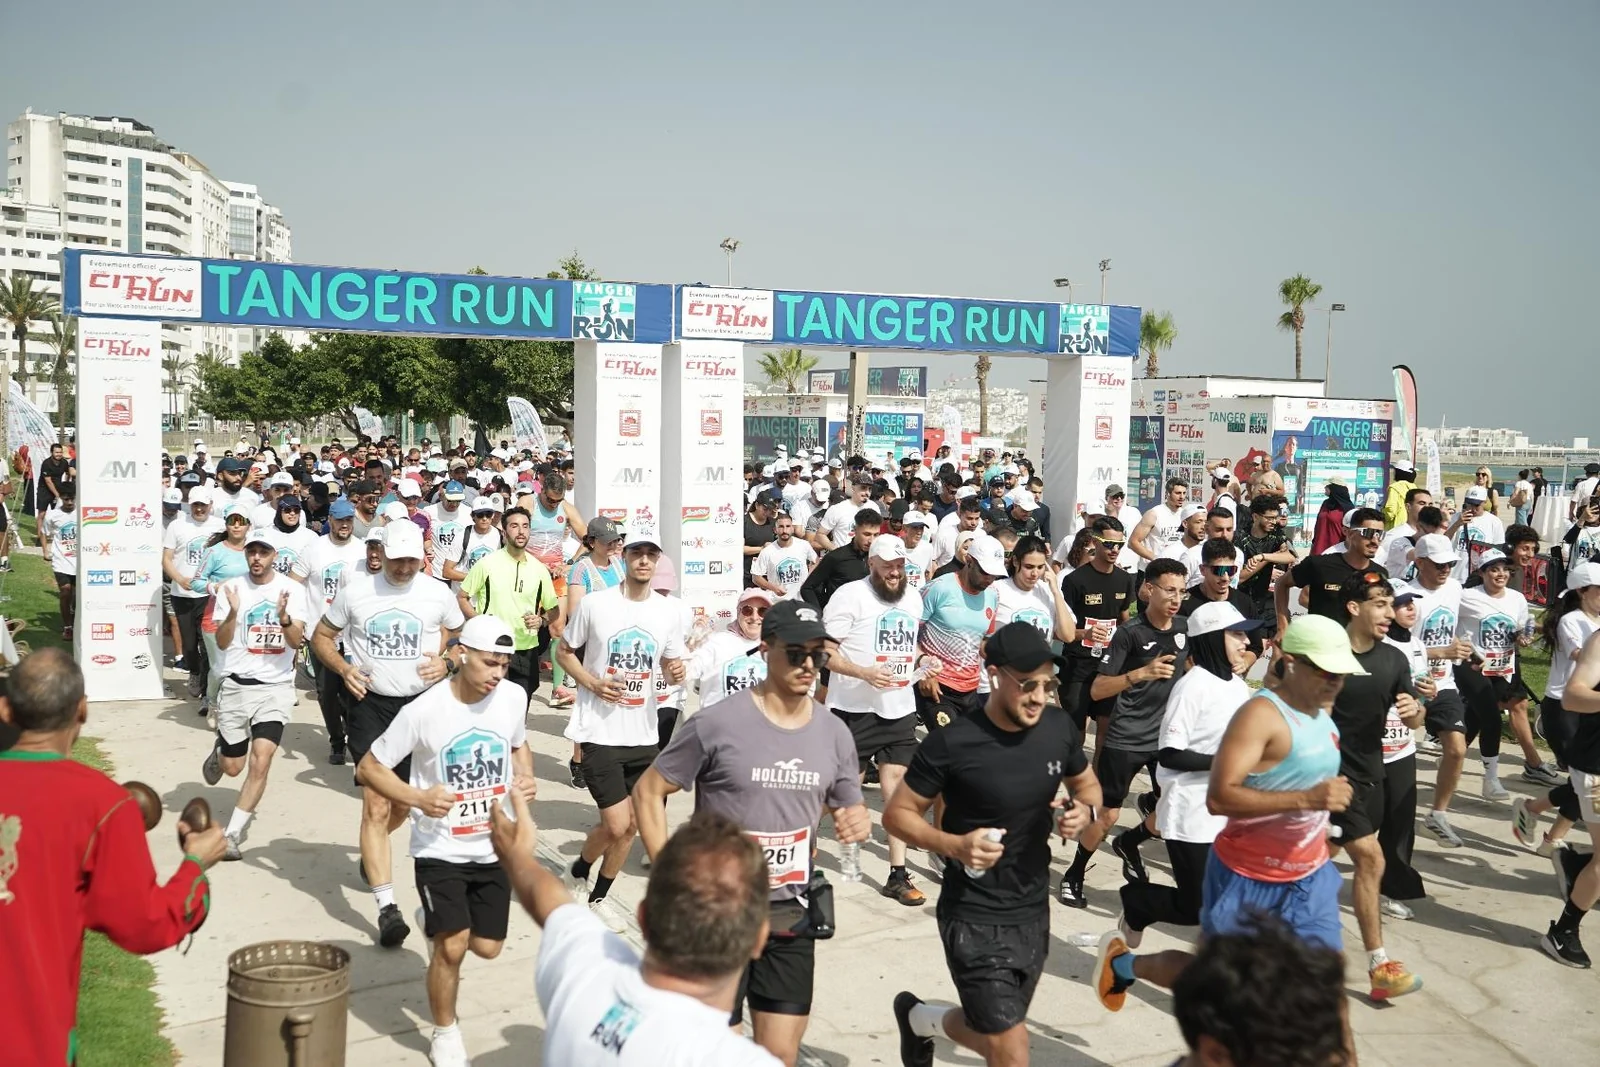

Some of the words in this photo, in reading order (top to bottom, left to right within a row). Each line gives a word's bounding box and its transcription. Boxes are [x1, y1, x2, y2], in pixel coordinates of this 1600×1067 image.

[89, 273, 166, 291] CITY
[126, 286, 194, 303] RUN
[207, 264, 437, 325] TANGER
[451, 283, 553, 327] RUN
[574, 282, 635, 297] TANGER
[688, 302, 746, 316] CITY
[1062, 304, 1108, 317] TANGER
[716, 314, 768, 328] RUN
[778, 294, 955, 345] TANGER
[965, 306, 1046, 345] RUN
[573, 315, 635, 339] RUN
[84, 338, 132, 349] CITY
[1059, 334, 1108, 354] RUN
[107, 347, 151, 357] RUN
[604, 359, 642, 369] CITY
[685, 361, 722, 370] CITY
[623, 367, 657, 376] RUN
[703, 368, 736, 376] RUN
[1083, 371, 1115, 380] CITY
[1098, 377, 1126, 387] RUN
[866, 413, 905, 426] ANGER
[1209, 411, 1246, 423] TANGER
[745, 417, 798, 438] TANGER
[883, 425, 904, 435] RUN
[1168, 423, 1194, 433] CITY
[1228, 423, 1245, 432] RUN
[1249, 424, 1267, 434] RUN
[1311, 419, 1371, 437] TANGER
[1180, 430, 1204, 439] RUN
[1343, 437, 1370, 450] RUN
[685, 563, 705, 573] MAP
[88, 574, 112, 584] MAP
[120, 572, 136, 584] 2M
[256, 633, 282, 643] 2171
[879, 629, 914, 646] RUN
[1423, 625, 1454, 642] RUN
[370, 633, 419, 650] RUN
[371, 648, 417, 657] TANGER
[609, 652, 653, 670] RUN
[1382, 727, 1410, 739] 2314
[445, 757, 504, 783] RUN
[751, 767, 820, 786] HOLLISTER
[762, 782, 812, 791] CALIFORNIA
